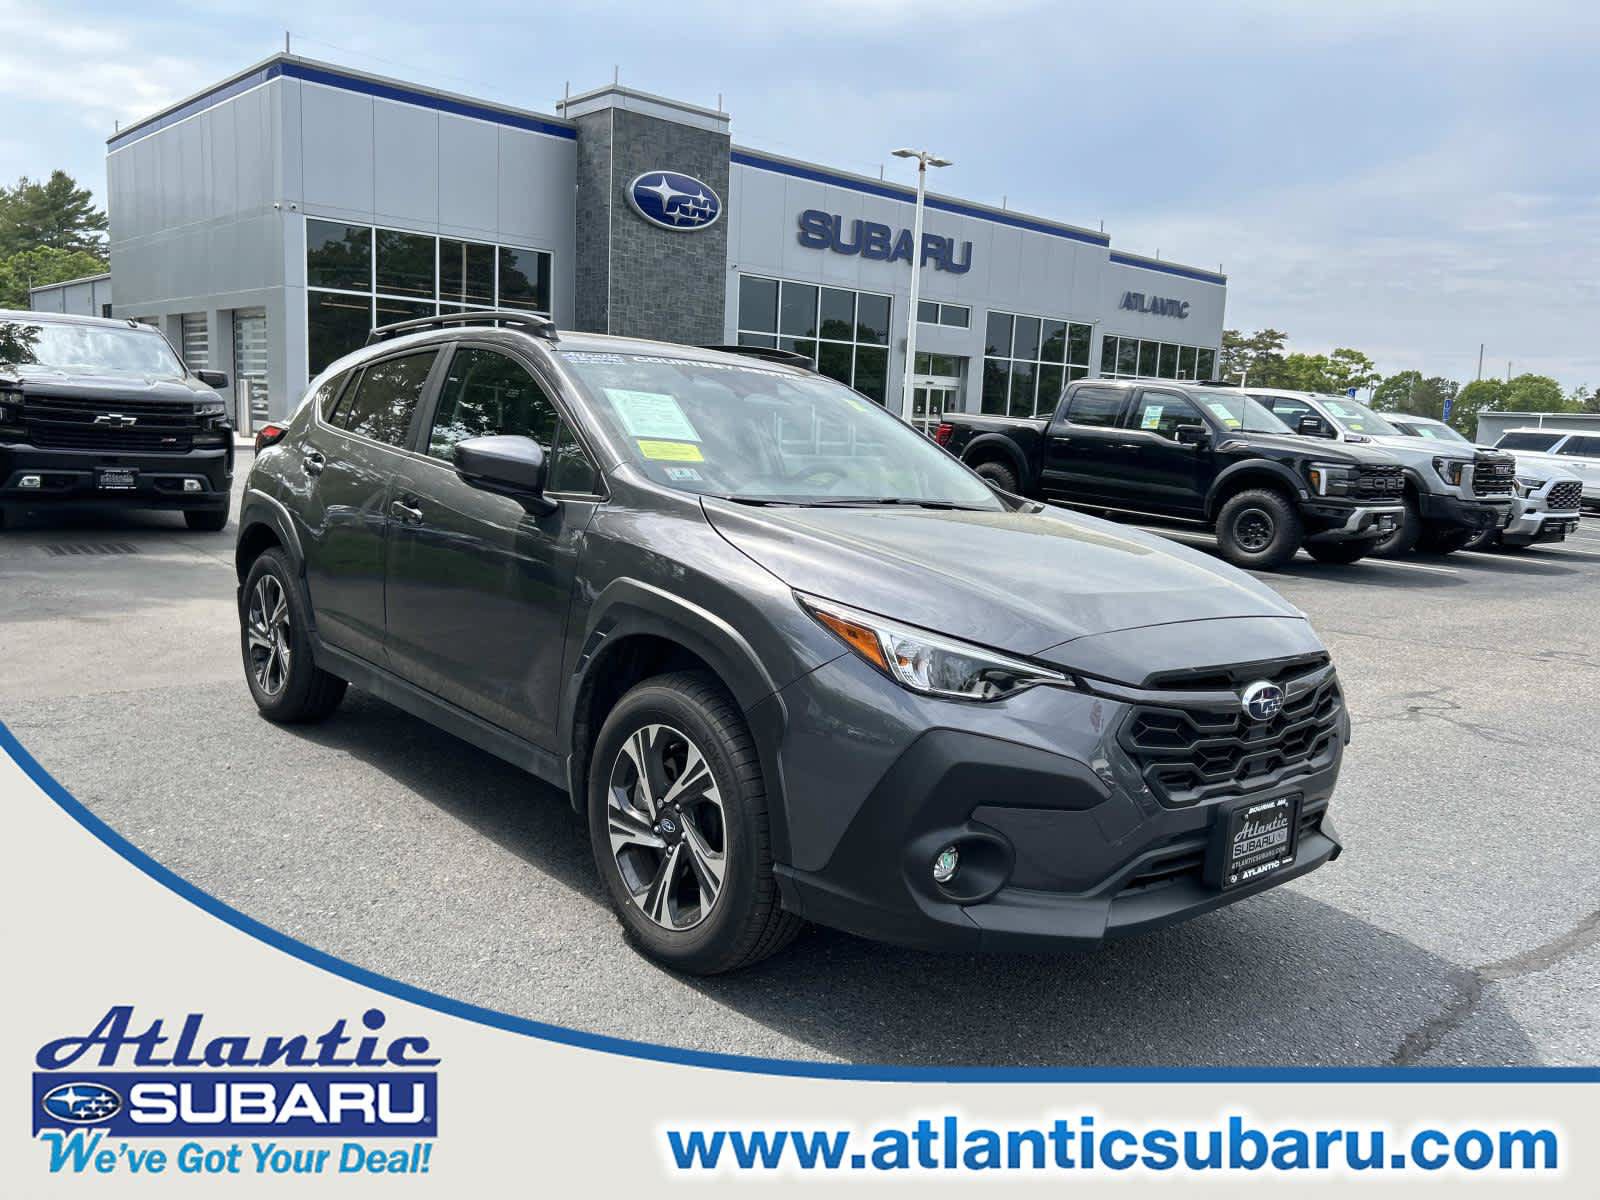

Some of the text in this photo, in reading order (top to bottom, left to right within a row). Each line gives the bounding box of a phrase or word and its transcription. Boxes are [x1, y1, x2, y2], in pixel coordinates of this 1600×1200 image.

[798, 209, 972, 274] SUBARU
[1119, 291, 1190, 319] ATLANTIC
[1233, 811, 1289, 843] Atlantic
[1234, 830, 1278, 857] SUBARU
[1243, 859, 1280, 879] ATLANTIC
